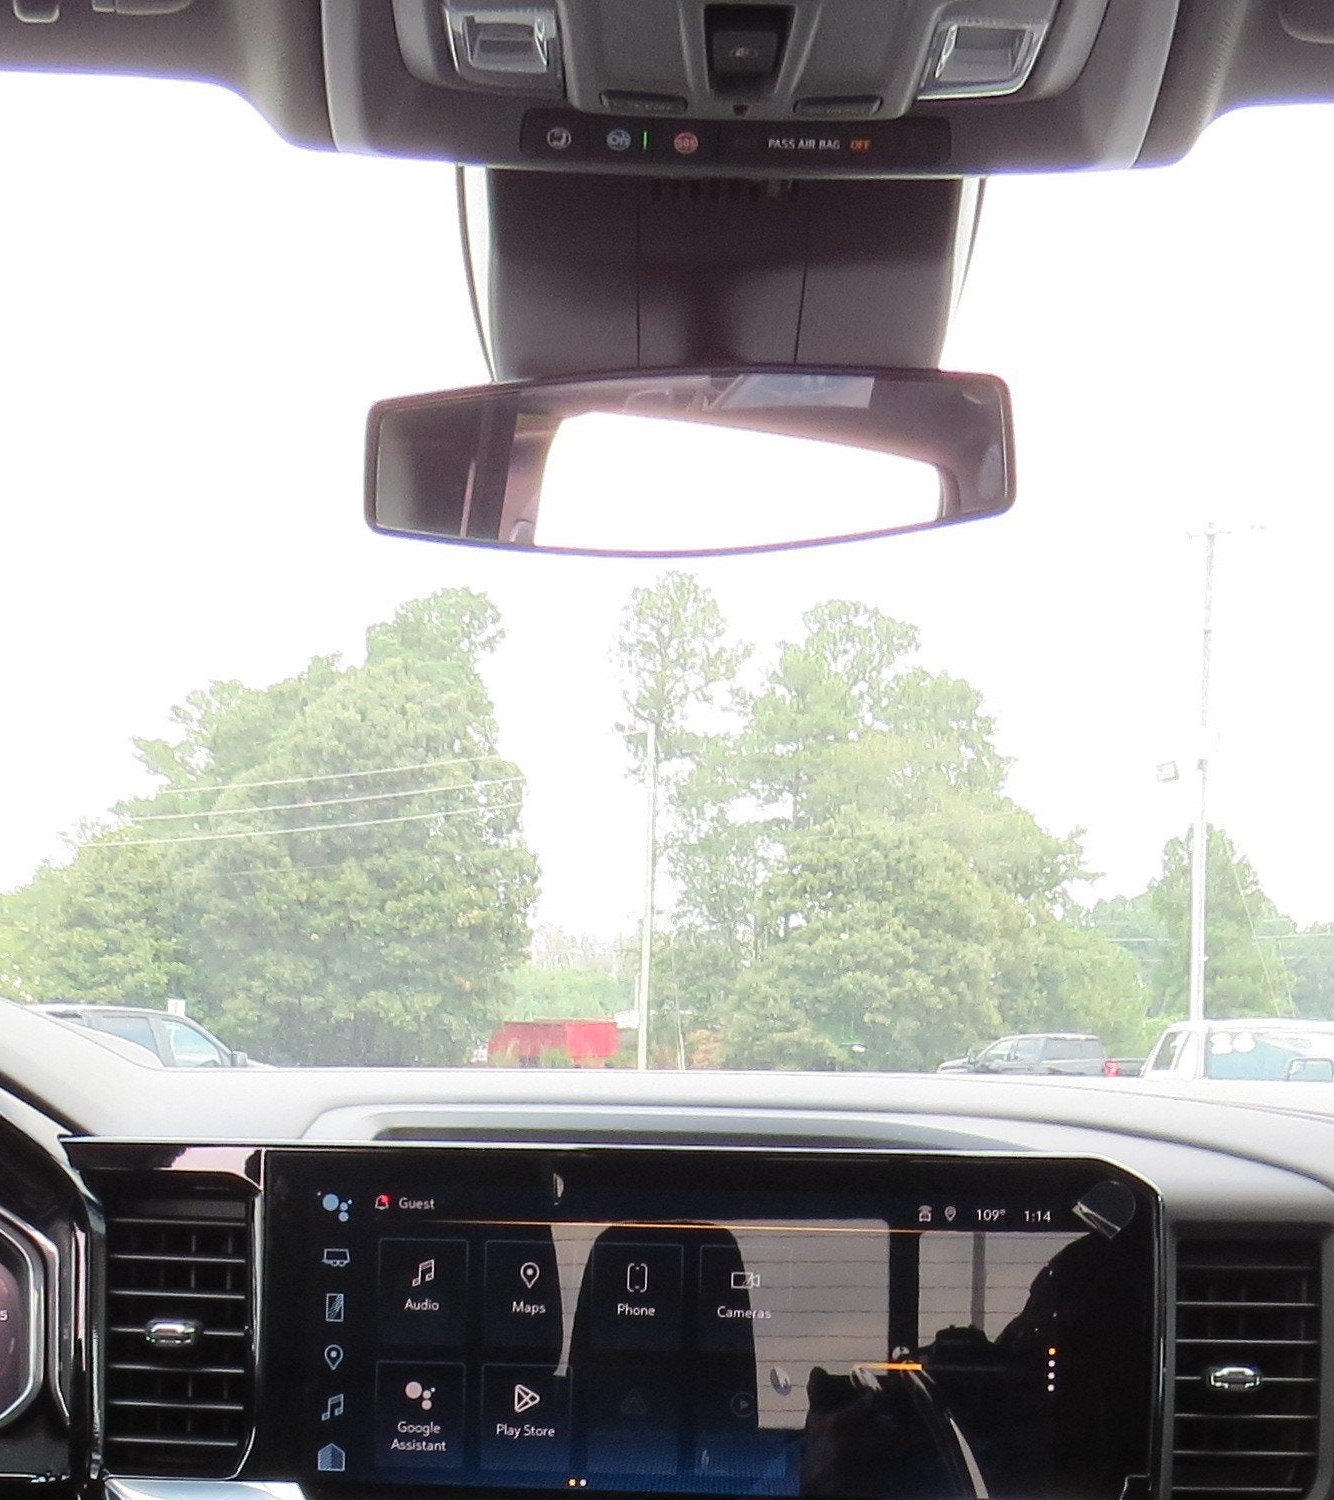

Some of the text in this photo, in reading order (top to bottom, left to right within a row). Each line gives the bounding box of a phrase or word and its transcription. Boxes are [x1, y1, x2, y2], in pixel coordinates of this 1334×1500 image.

[768, 139, 871, 150] PASS AIR BAG OFF
[398, 1197, 435, 1211] Guest
[1024, 1210, 1052, 1223] 1:14
[404, 1298, 440, 1312] Audio
[512, 1301, 546, 1316] Maps
[617, 1303, 656, 1317] Phone
[717, 1305, 771, 1320] Cameras
[397, 1420, 441, 1437] Google
[496, 1423, 556, 1439] Play Store
[390, 1438, 447, 1452] Assistant
